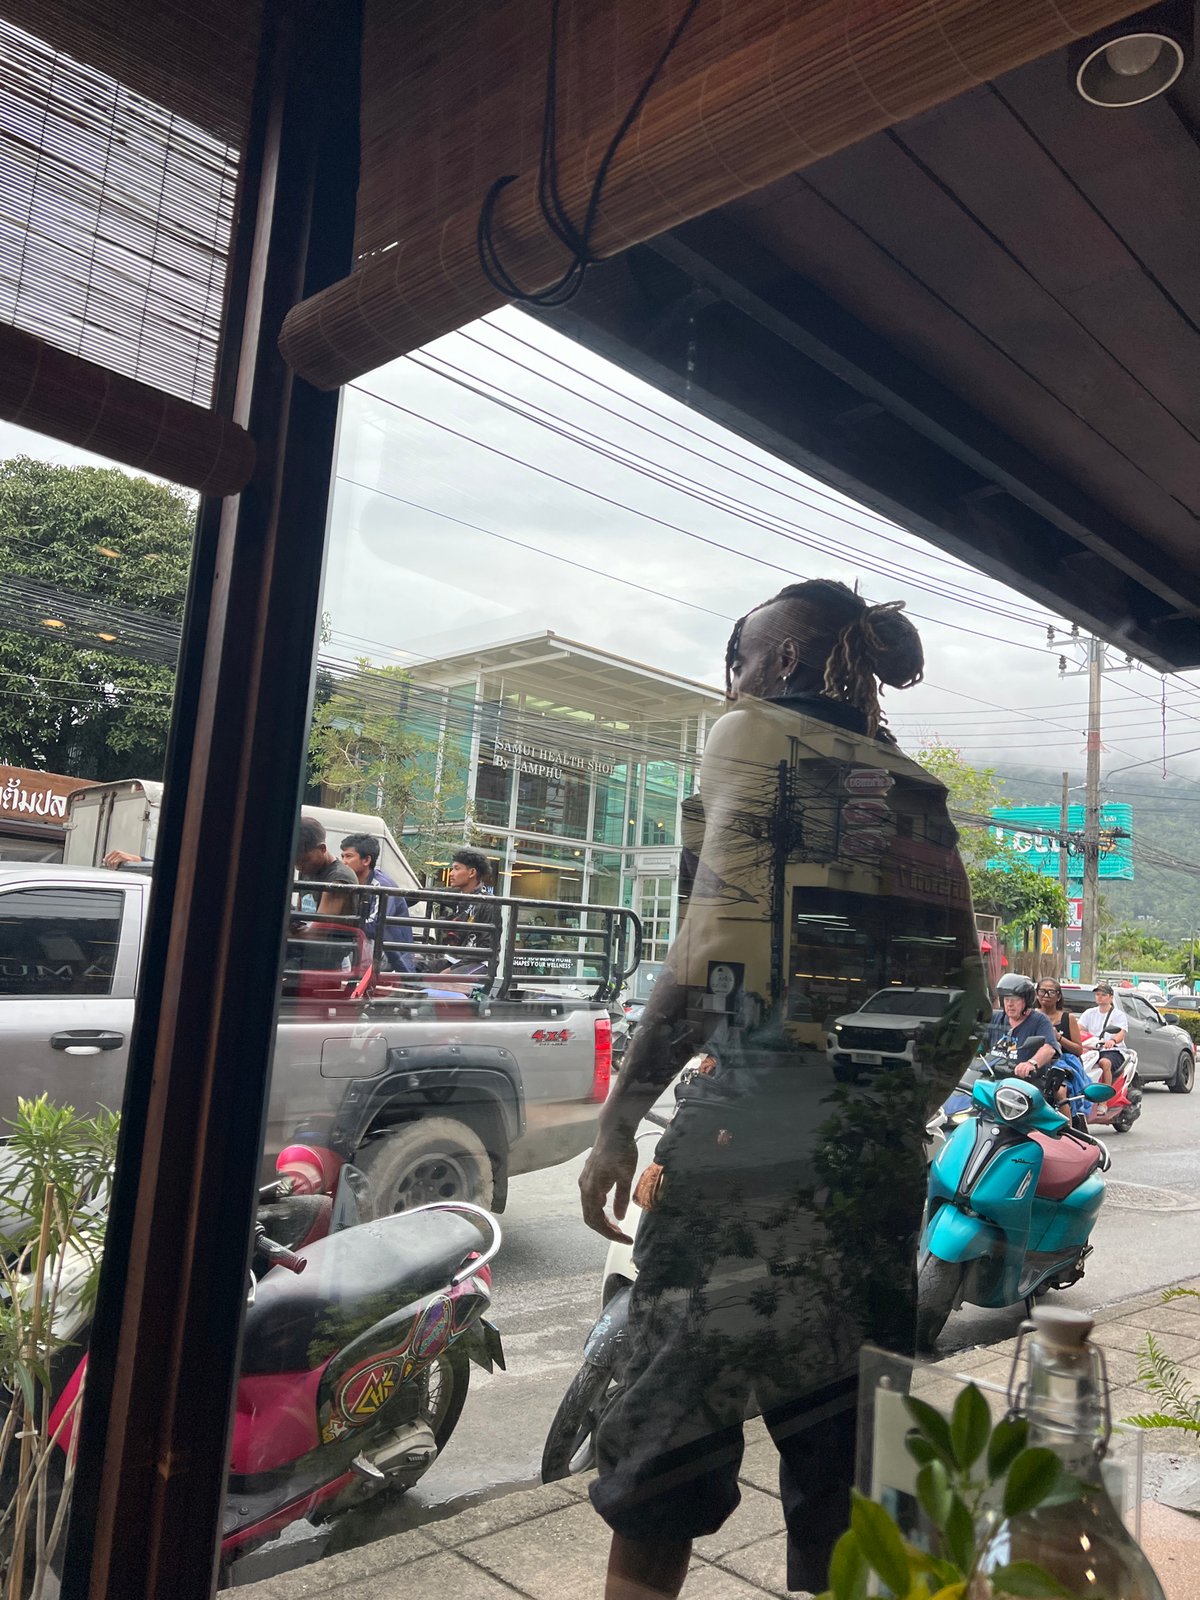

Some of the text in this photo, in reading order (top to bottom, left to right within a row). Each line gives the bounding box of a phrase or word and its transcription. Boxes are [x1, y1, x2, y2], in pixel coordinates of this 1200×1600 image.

[496, 740, 535, 758] SAMUI
[540, 749, 584, 769] HEALTH
[496, 755, 562, 780] By LAMPHU
[0, 778, 67, 817] ต้มปล
